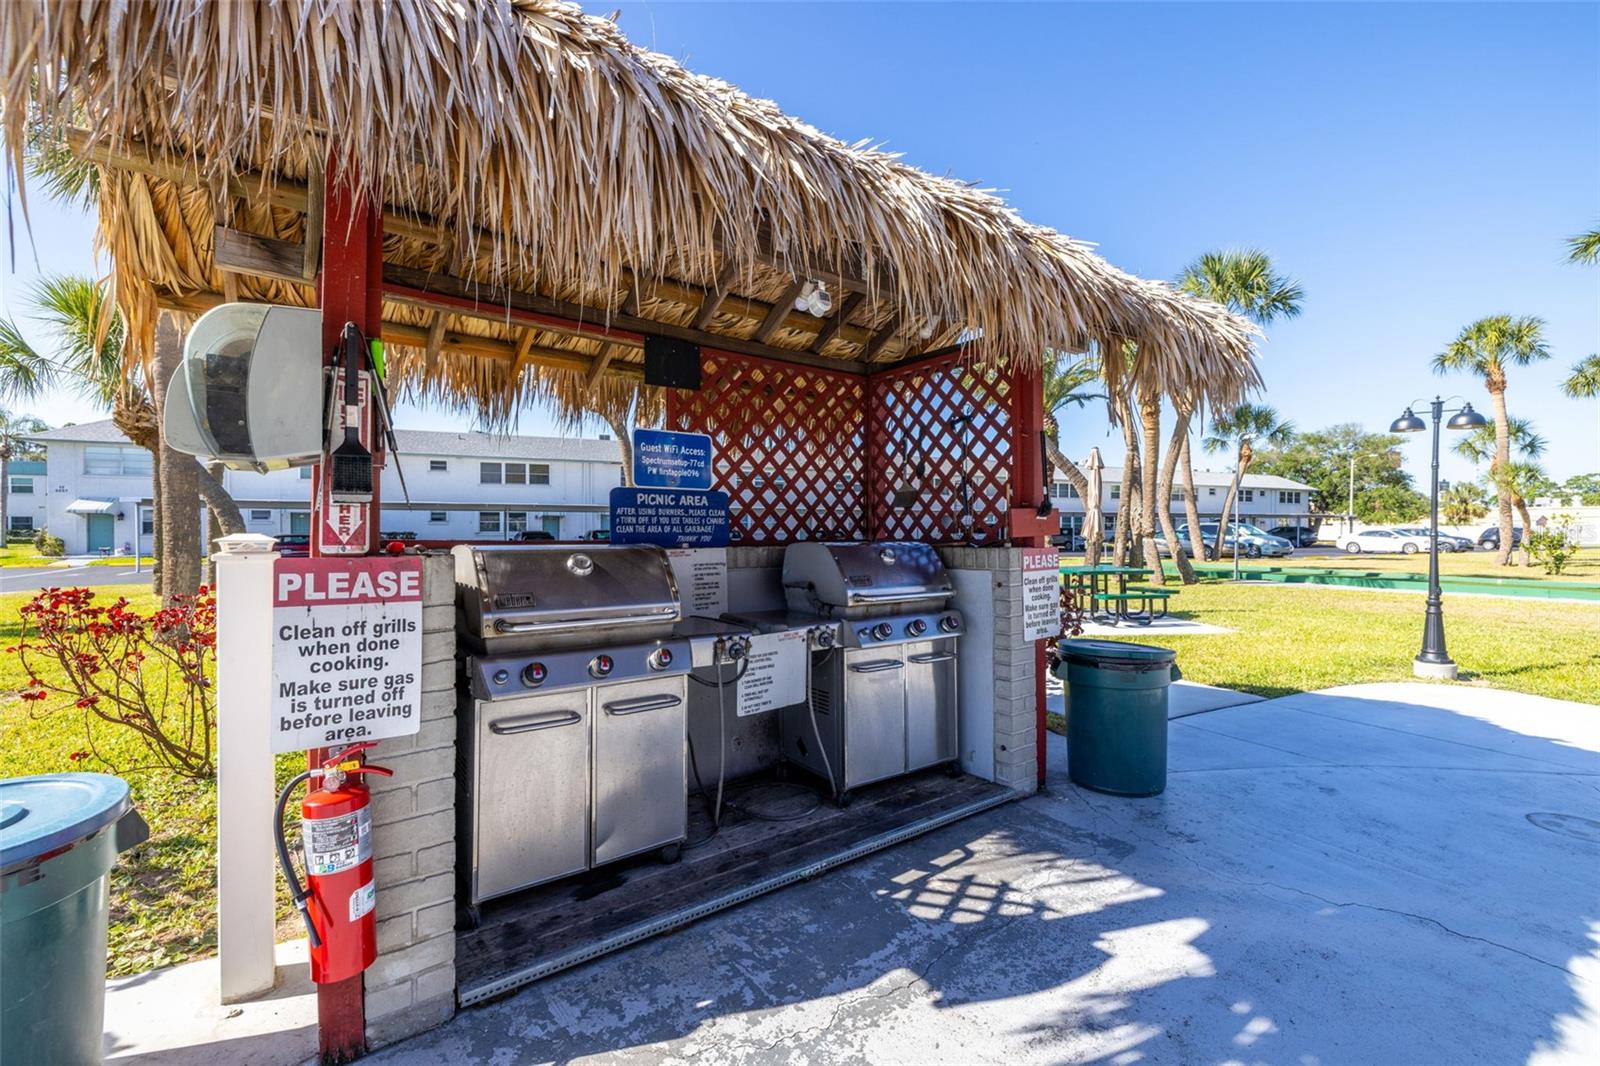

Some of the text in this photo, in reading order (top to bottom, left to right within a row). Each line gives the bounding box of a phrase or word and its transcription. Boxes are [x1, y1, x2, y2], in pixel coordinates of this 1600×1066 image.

[641, 442, 706, 456] Guest WiFi Access:
[648, 467, 657, 475] PW
[637, 493, 708, 506] PICNIC AREA
[638, 508, 656, 516] USING
[616, 525, 633, 533] CLEAN
[635, 525, 646, 533] THE
[1024, 555, 1058, 569] PLEASE
[278, 571, 420, 601] PLEASE
[1024, 577, 1038, 585] Clean
[1046, 575, 1057, 584] grills
[1032, 593, 1051, 601] cooking.
[1025, 604, 1038, 612] Make
[1050, 602, 1058, 610] gas
[1033, 611, 1048, 619] turned
[279, 618, 416, 640] Clean off grills
[1026, 619, 1040, 628] before
[298, 638, 400, 657] when done
[310, 655, 389, 674] cooking.
[280, 673, 414, 698] Make sure gas
[290, 686, 406, 714] is turned off
[280, 703, 412, 732] before leaving
[325, 726, 372, 741] area.
